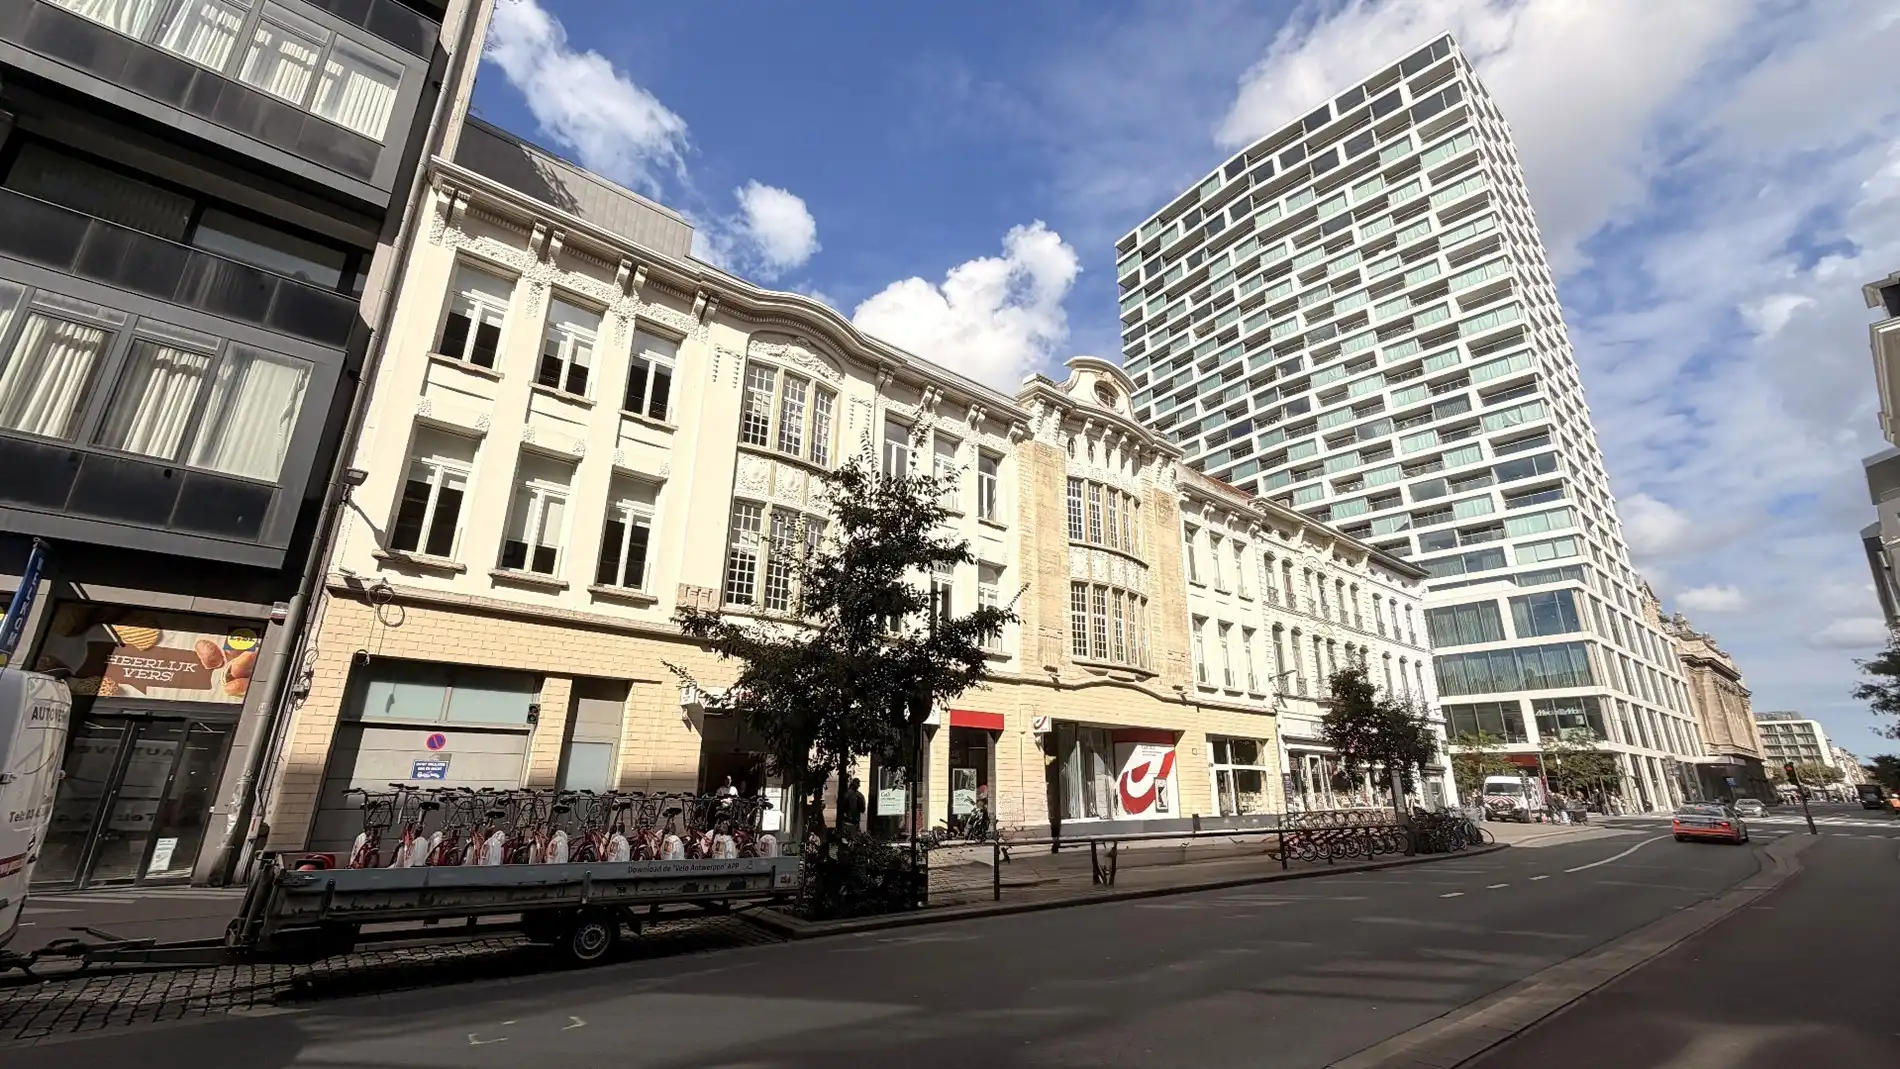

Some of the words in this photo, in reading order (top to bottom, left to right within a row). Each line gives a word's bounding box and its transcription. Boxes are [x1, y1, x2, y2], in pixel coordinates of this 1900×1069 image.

[105, 655, 198, 672] HEERLIJK
[123, 668, 175, 682] VERS!
[628, 864, 662, 873] Download
[663, 864, 672, 872] de
[727, 862, 740, 870] APP
